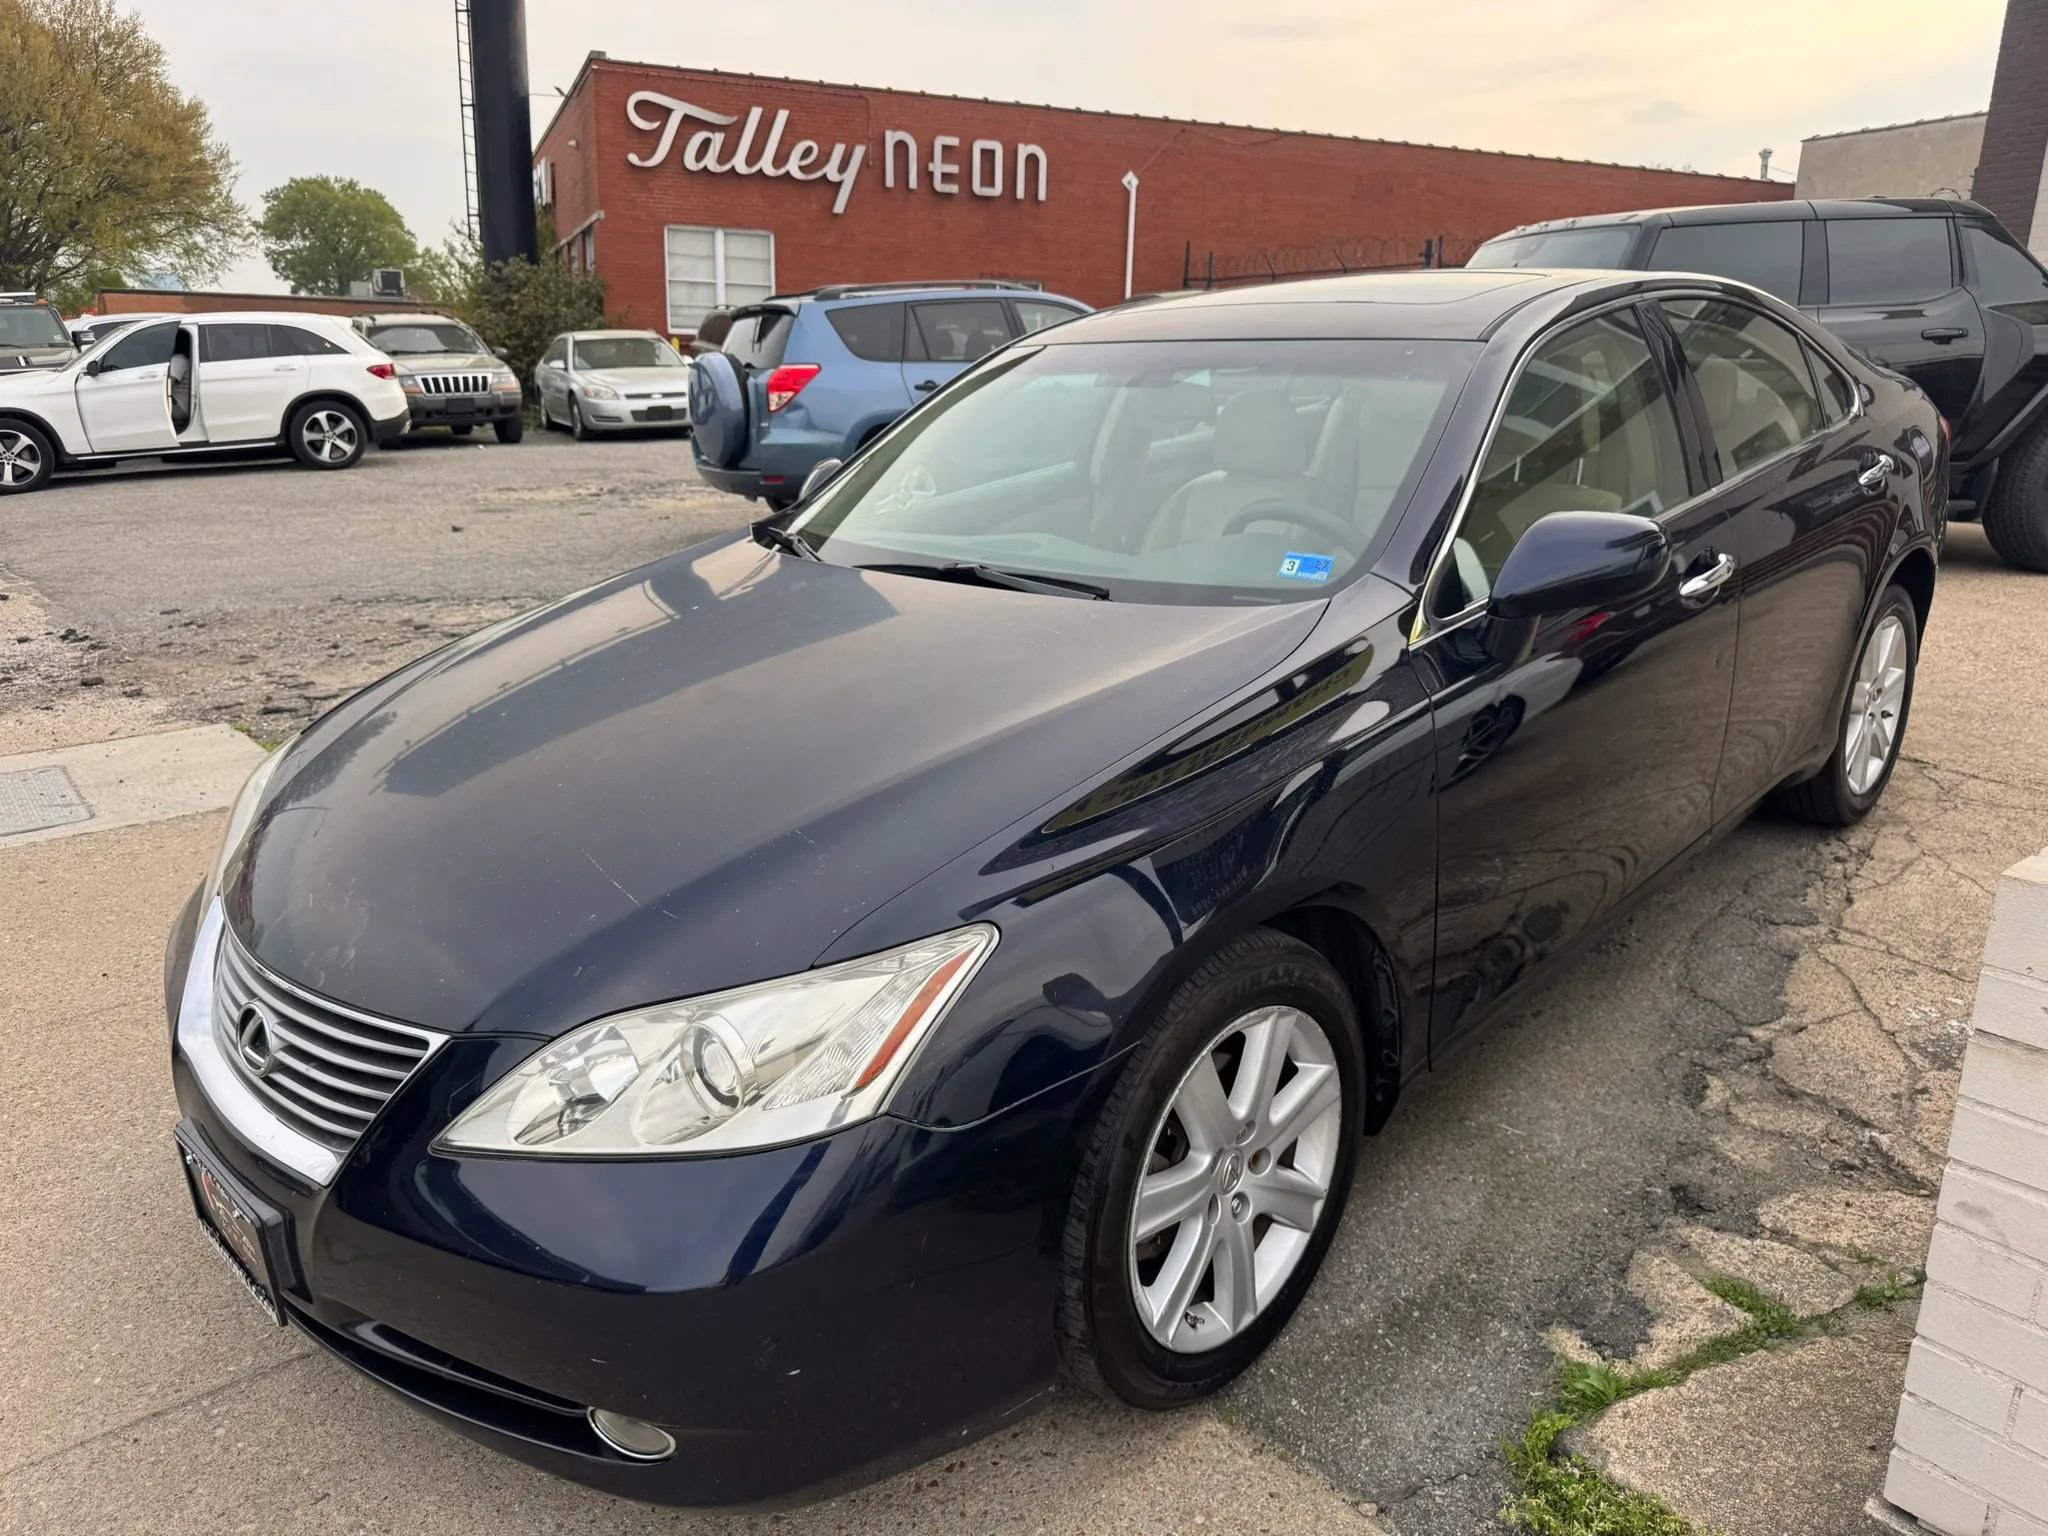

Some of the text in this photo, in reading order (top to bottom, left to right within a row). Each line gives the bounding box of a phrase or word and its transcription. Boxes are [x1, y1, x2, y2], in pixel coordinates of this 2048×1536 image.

[626, 90, 1048, 214] Talley NEON
[1286, 560, 1296, 571] 3
